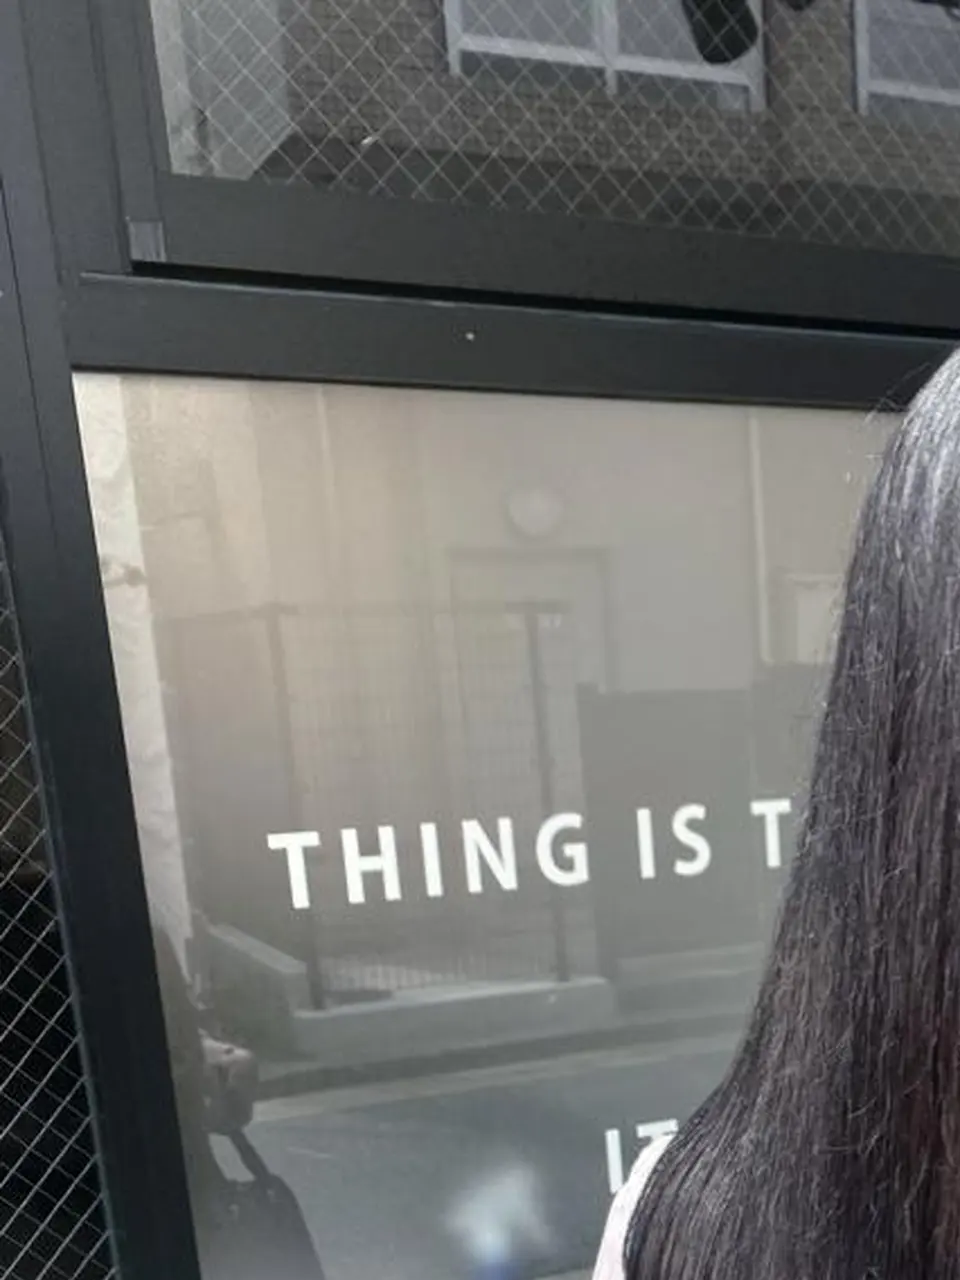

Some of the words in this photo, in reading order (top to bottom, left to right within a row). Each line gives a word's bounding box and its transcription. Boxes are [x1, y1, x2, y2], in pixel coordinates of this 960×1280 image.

[267, 813, 590, 910] THING
[636, 803, 711, 879] IS
[750, 798, 791, 869] T
